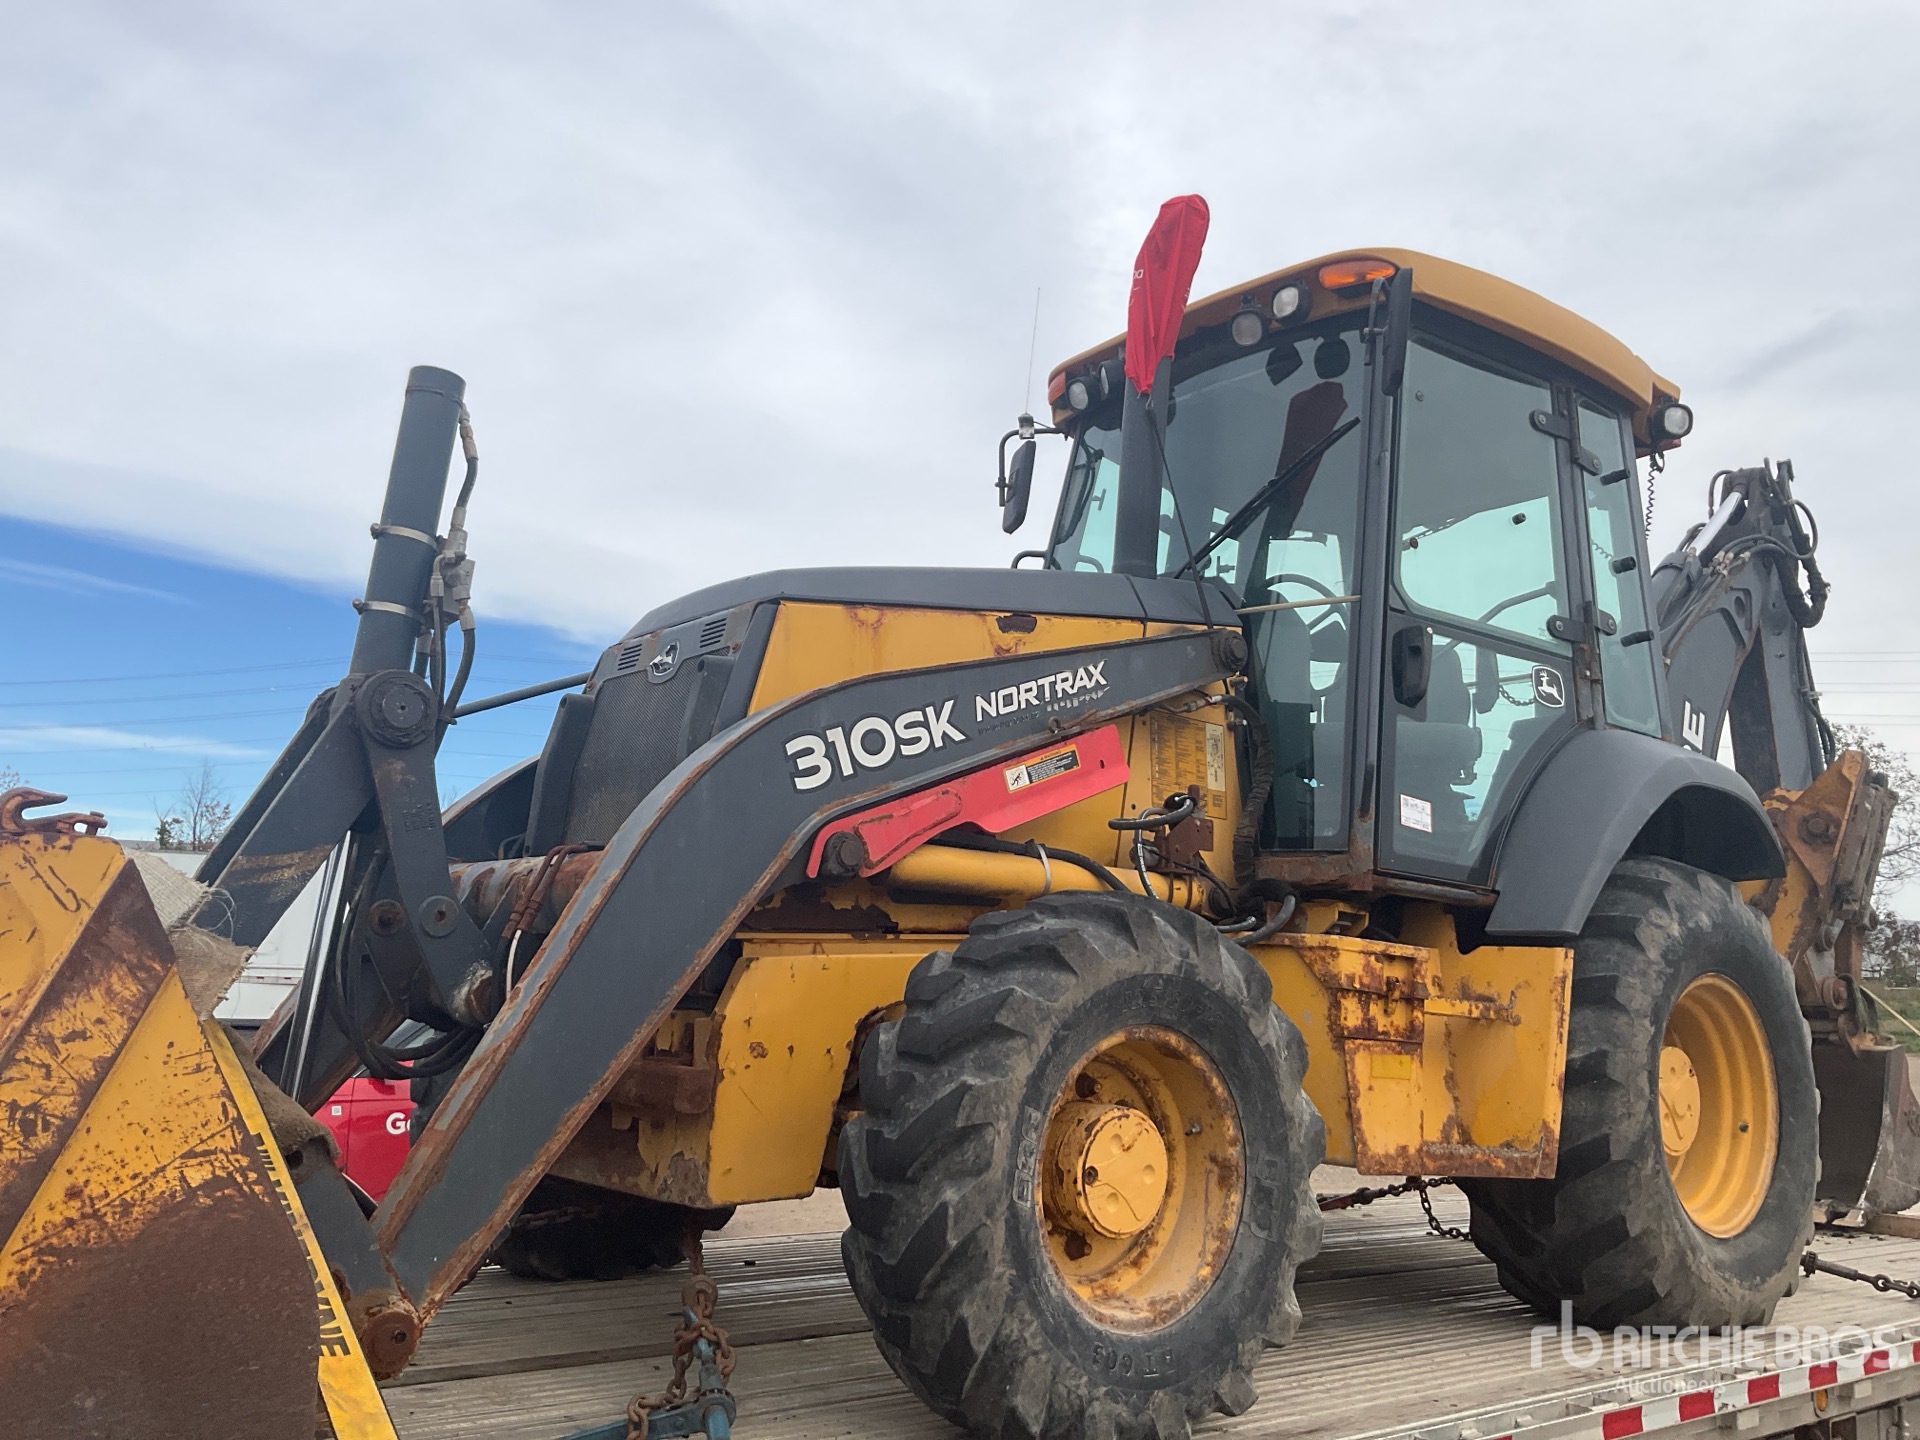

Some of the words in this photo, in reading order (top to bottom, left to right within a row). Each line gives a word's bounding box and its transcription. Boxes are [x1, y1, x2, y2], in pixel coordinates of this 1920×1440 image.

[975, 660, 1107, 722] NORTRAX
[785, 700, 966, 790] 310SK
[1683, 701, 1705, 750] E
[386, 1112, 410, 1135] G
